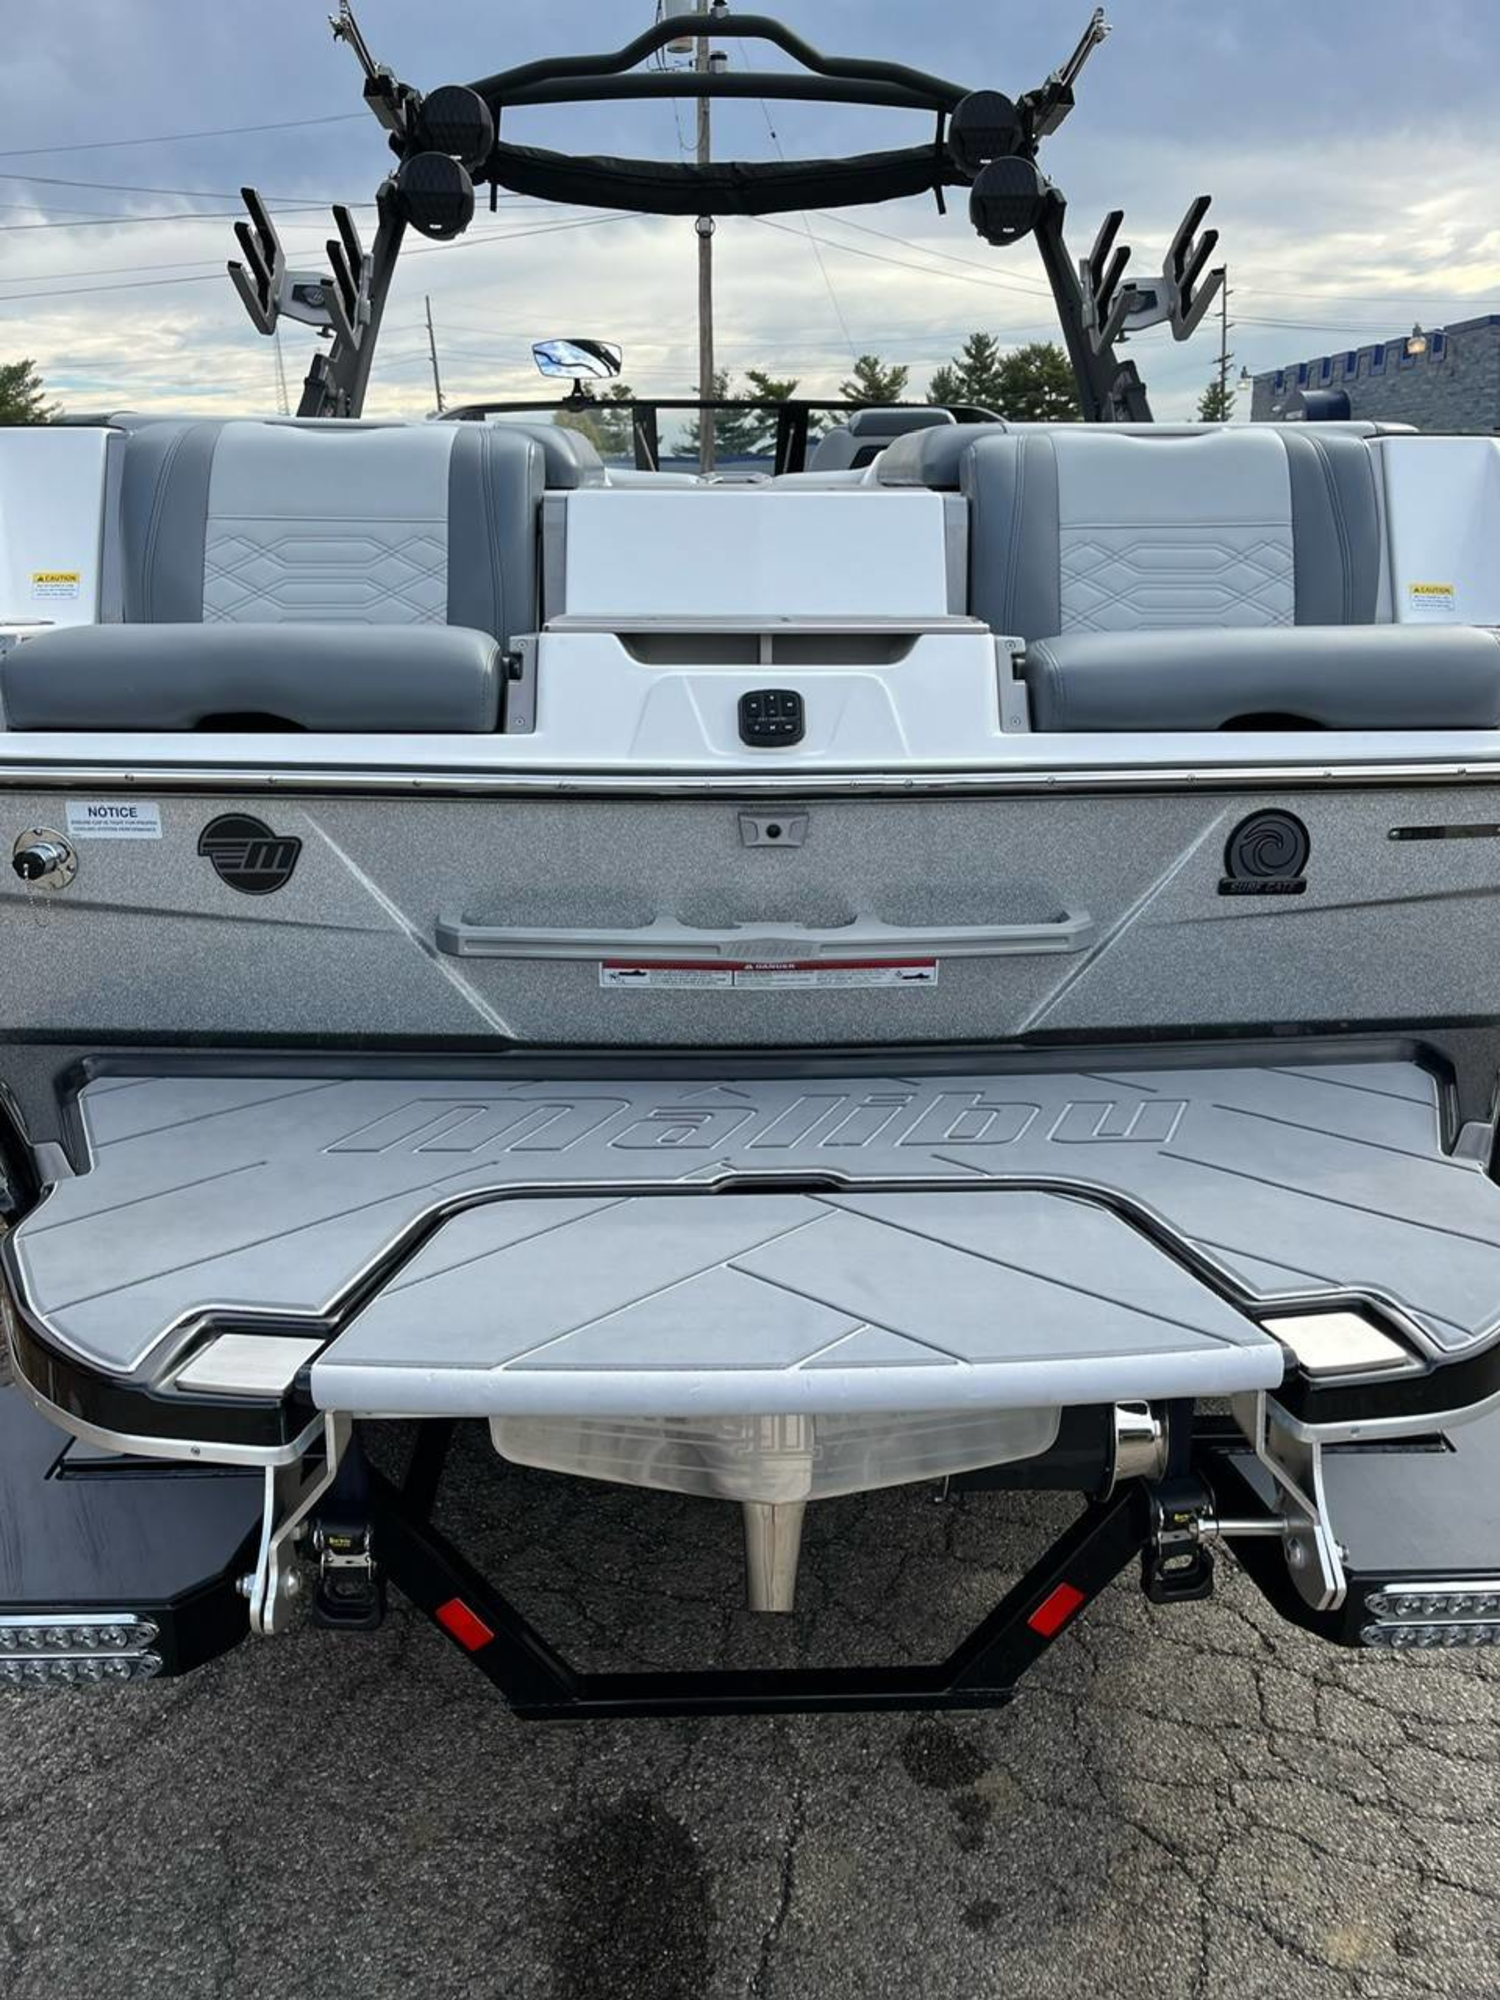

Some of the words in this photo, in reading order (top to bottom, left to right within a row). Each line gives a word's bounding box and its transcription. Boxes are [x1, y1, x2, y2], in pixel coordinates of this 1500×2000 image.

[45, 574, 76, 583] CAUTION
[1420, 586, 1451, 595] CAUTION
[87, 807, 138, 818] NOTICE
